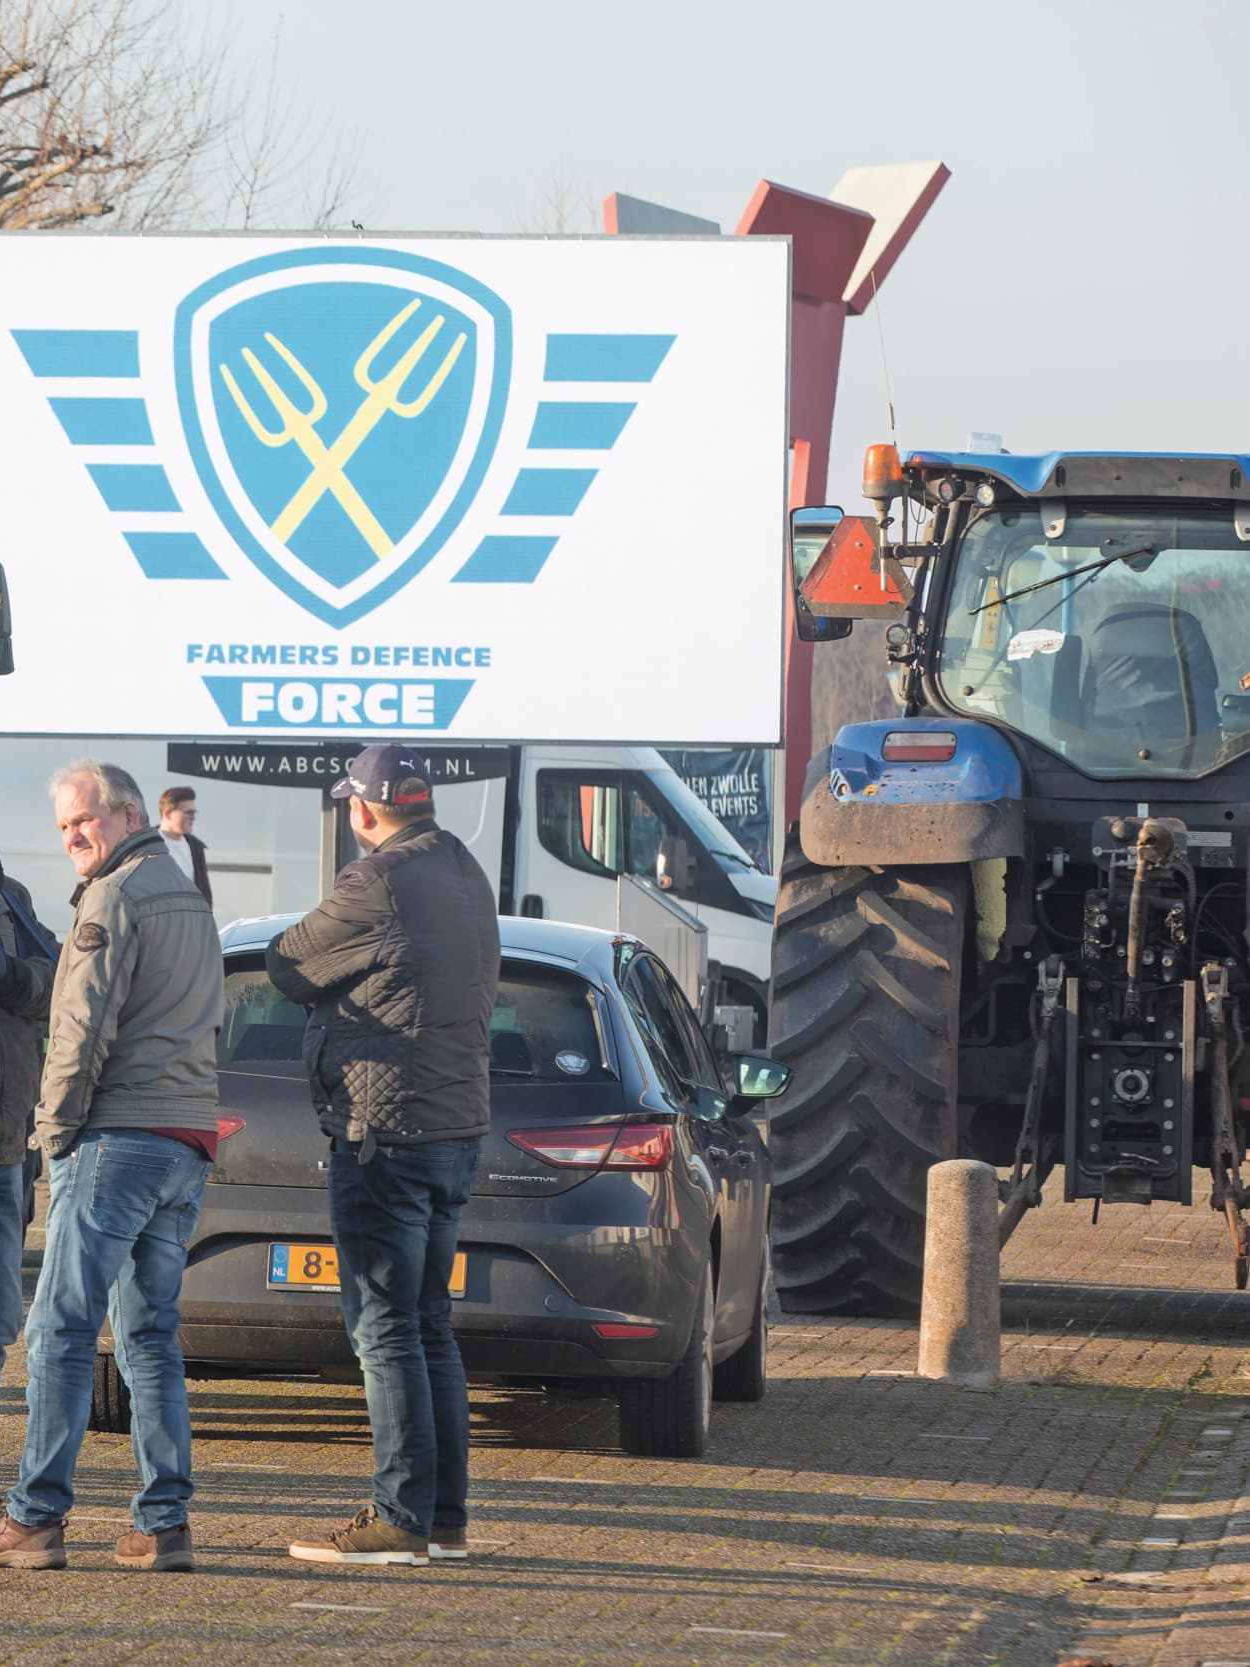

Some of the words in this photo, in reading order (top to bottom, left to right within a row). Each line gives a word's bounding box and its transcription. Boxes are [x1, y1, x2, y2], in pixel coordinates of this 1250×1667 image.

[186, 643, 339, 666] FARMERS
[350, 645, 492, 668] DEFENCE
[240, 681, 435, 725] FORCE
[710, 772, 760, 796] ZWOLLE
[711, 795, 759, 817] EVENTS
[272, 1266, 286, 1278] NL
